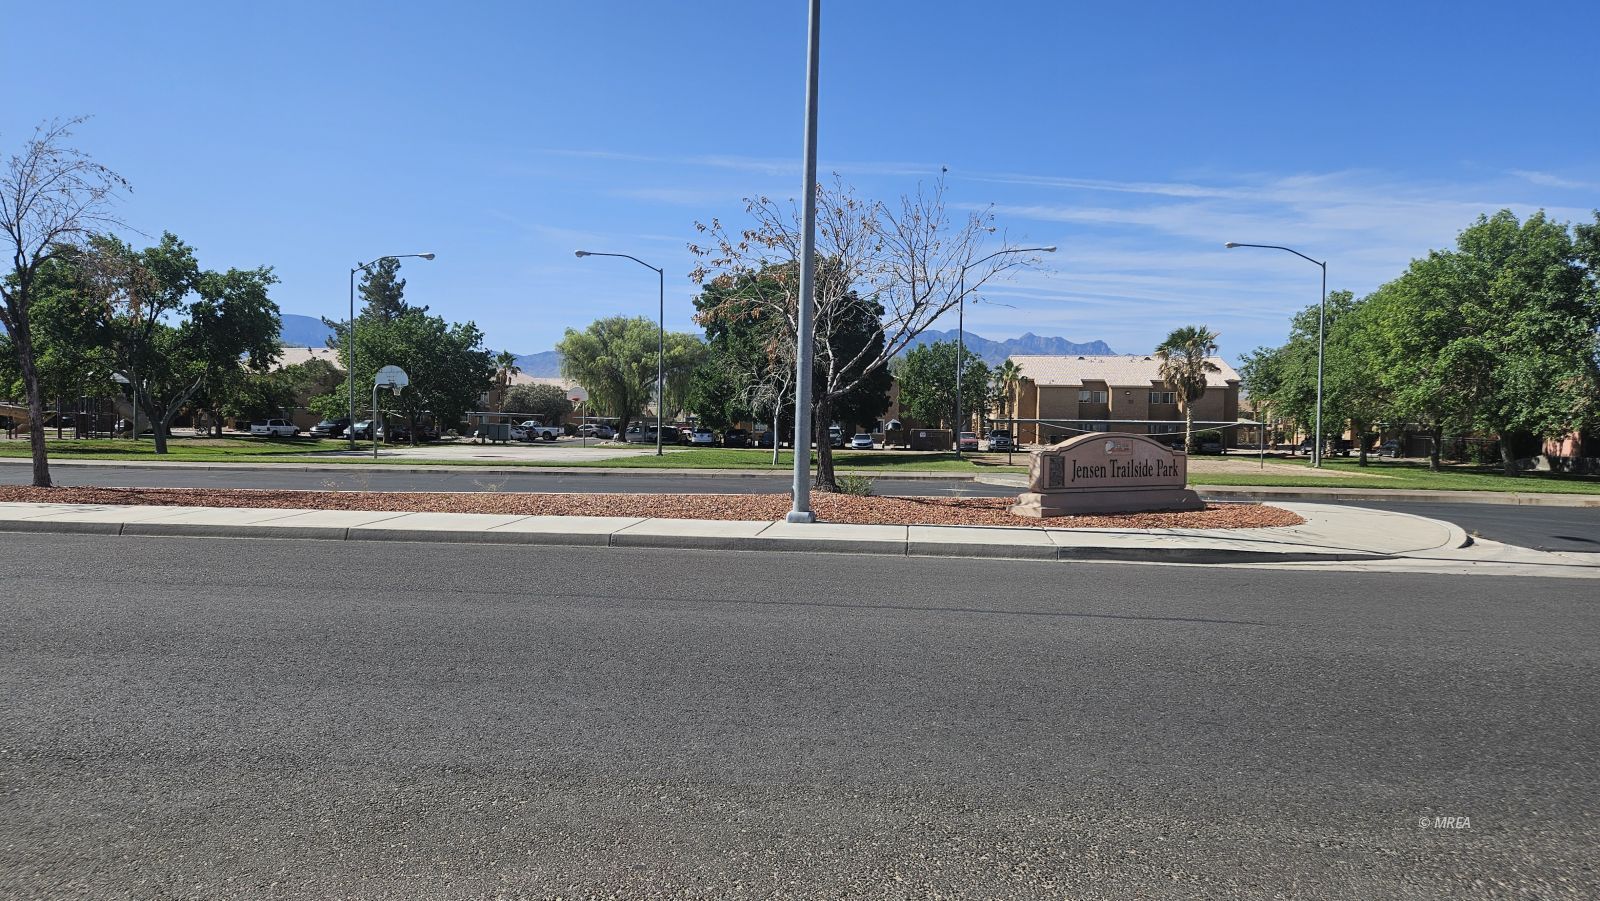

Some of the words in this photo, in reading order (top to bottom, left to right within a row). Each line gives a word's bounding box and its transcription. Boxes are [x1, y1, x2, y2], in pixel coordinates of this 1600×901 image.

[1071, 459, 1107, 482] Jensen
[1110, 458, 1153, 478] Trailside
[1156, 458, 1178, 478] Park
